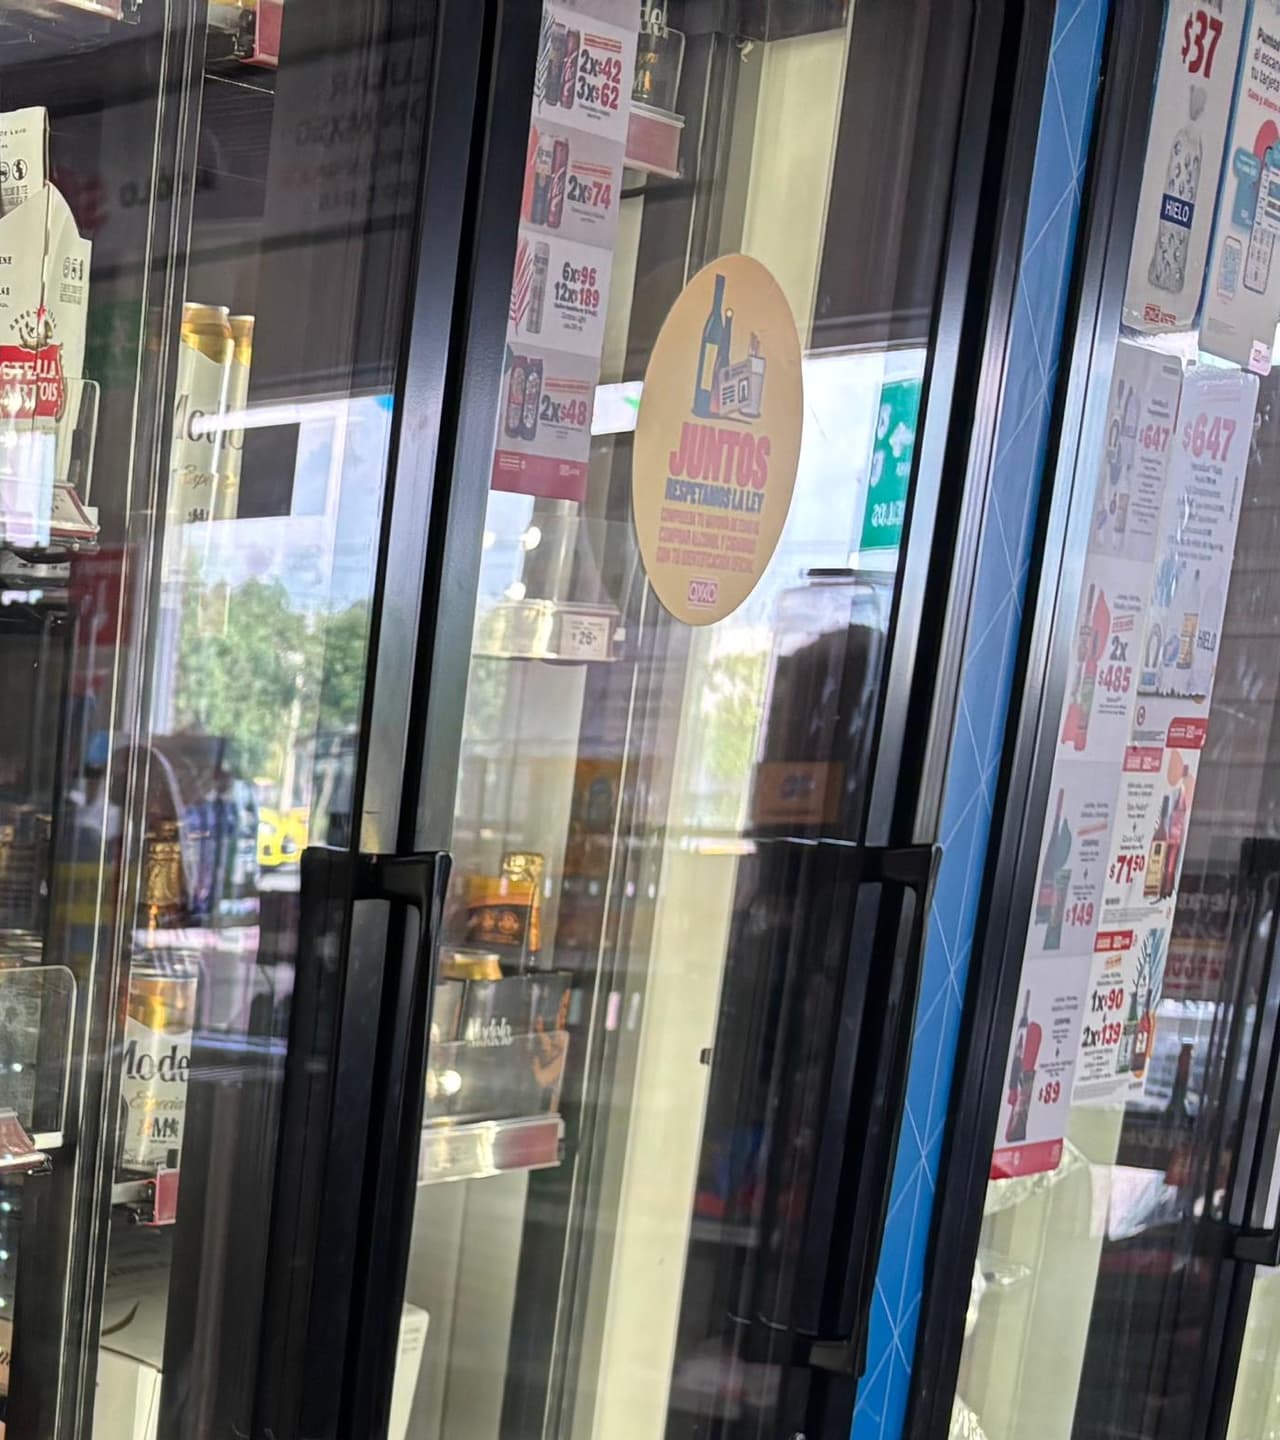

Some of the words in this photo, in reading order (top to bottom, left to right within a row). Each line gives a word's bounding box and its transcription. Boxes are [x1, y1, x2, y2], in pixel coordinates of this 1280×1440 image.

[1181, 10, 1223, 79] $37
[1165, 200, 1190, 223] HIELO
[668, 421, 771, 490] JUNTOS
[1182, 413, 1238, 462] $647
